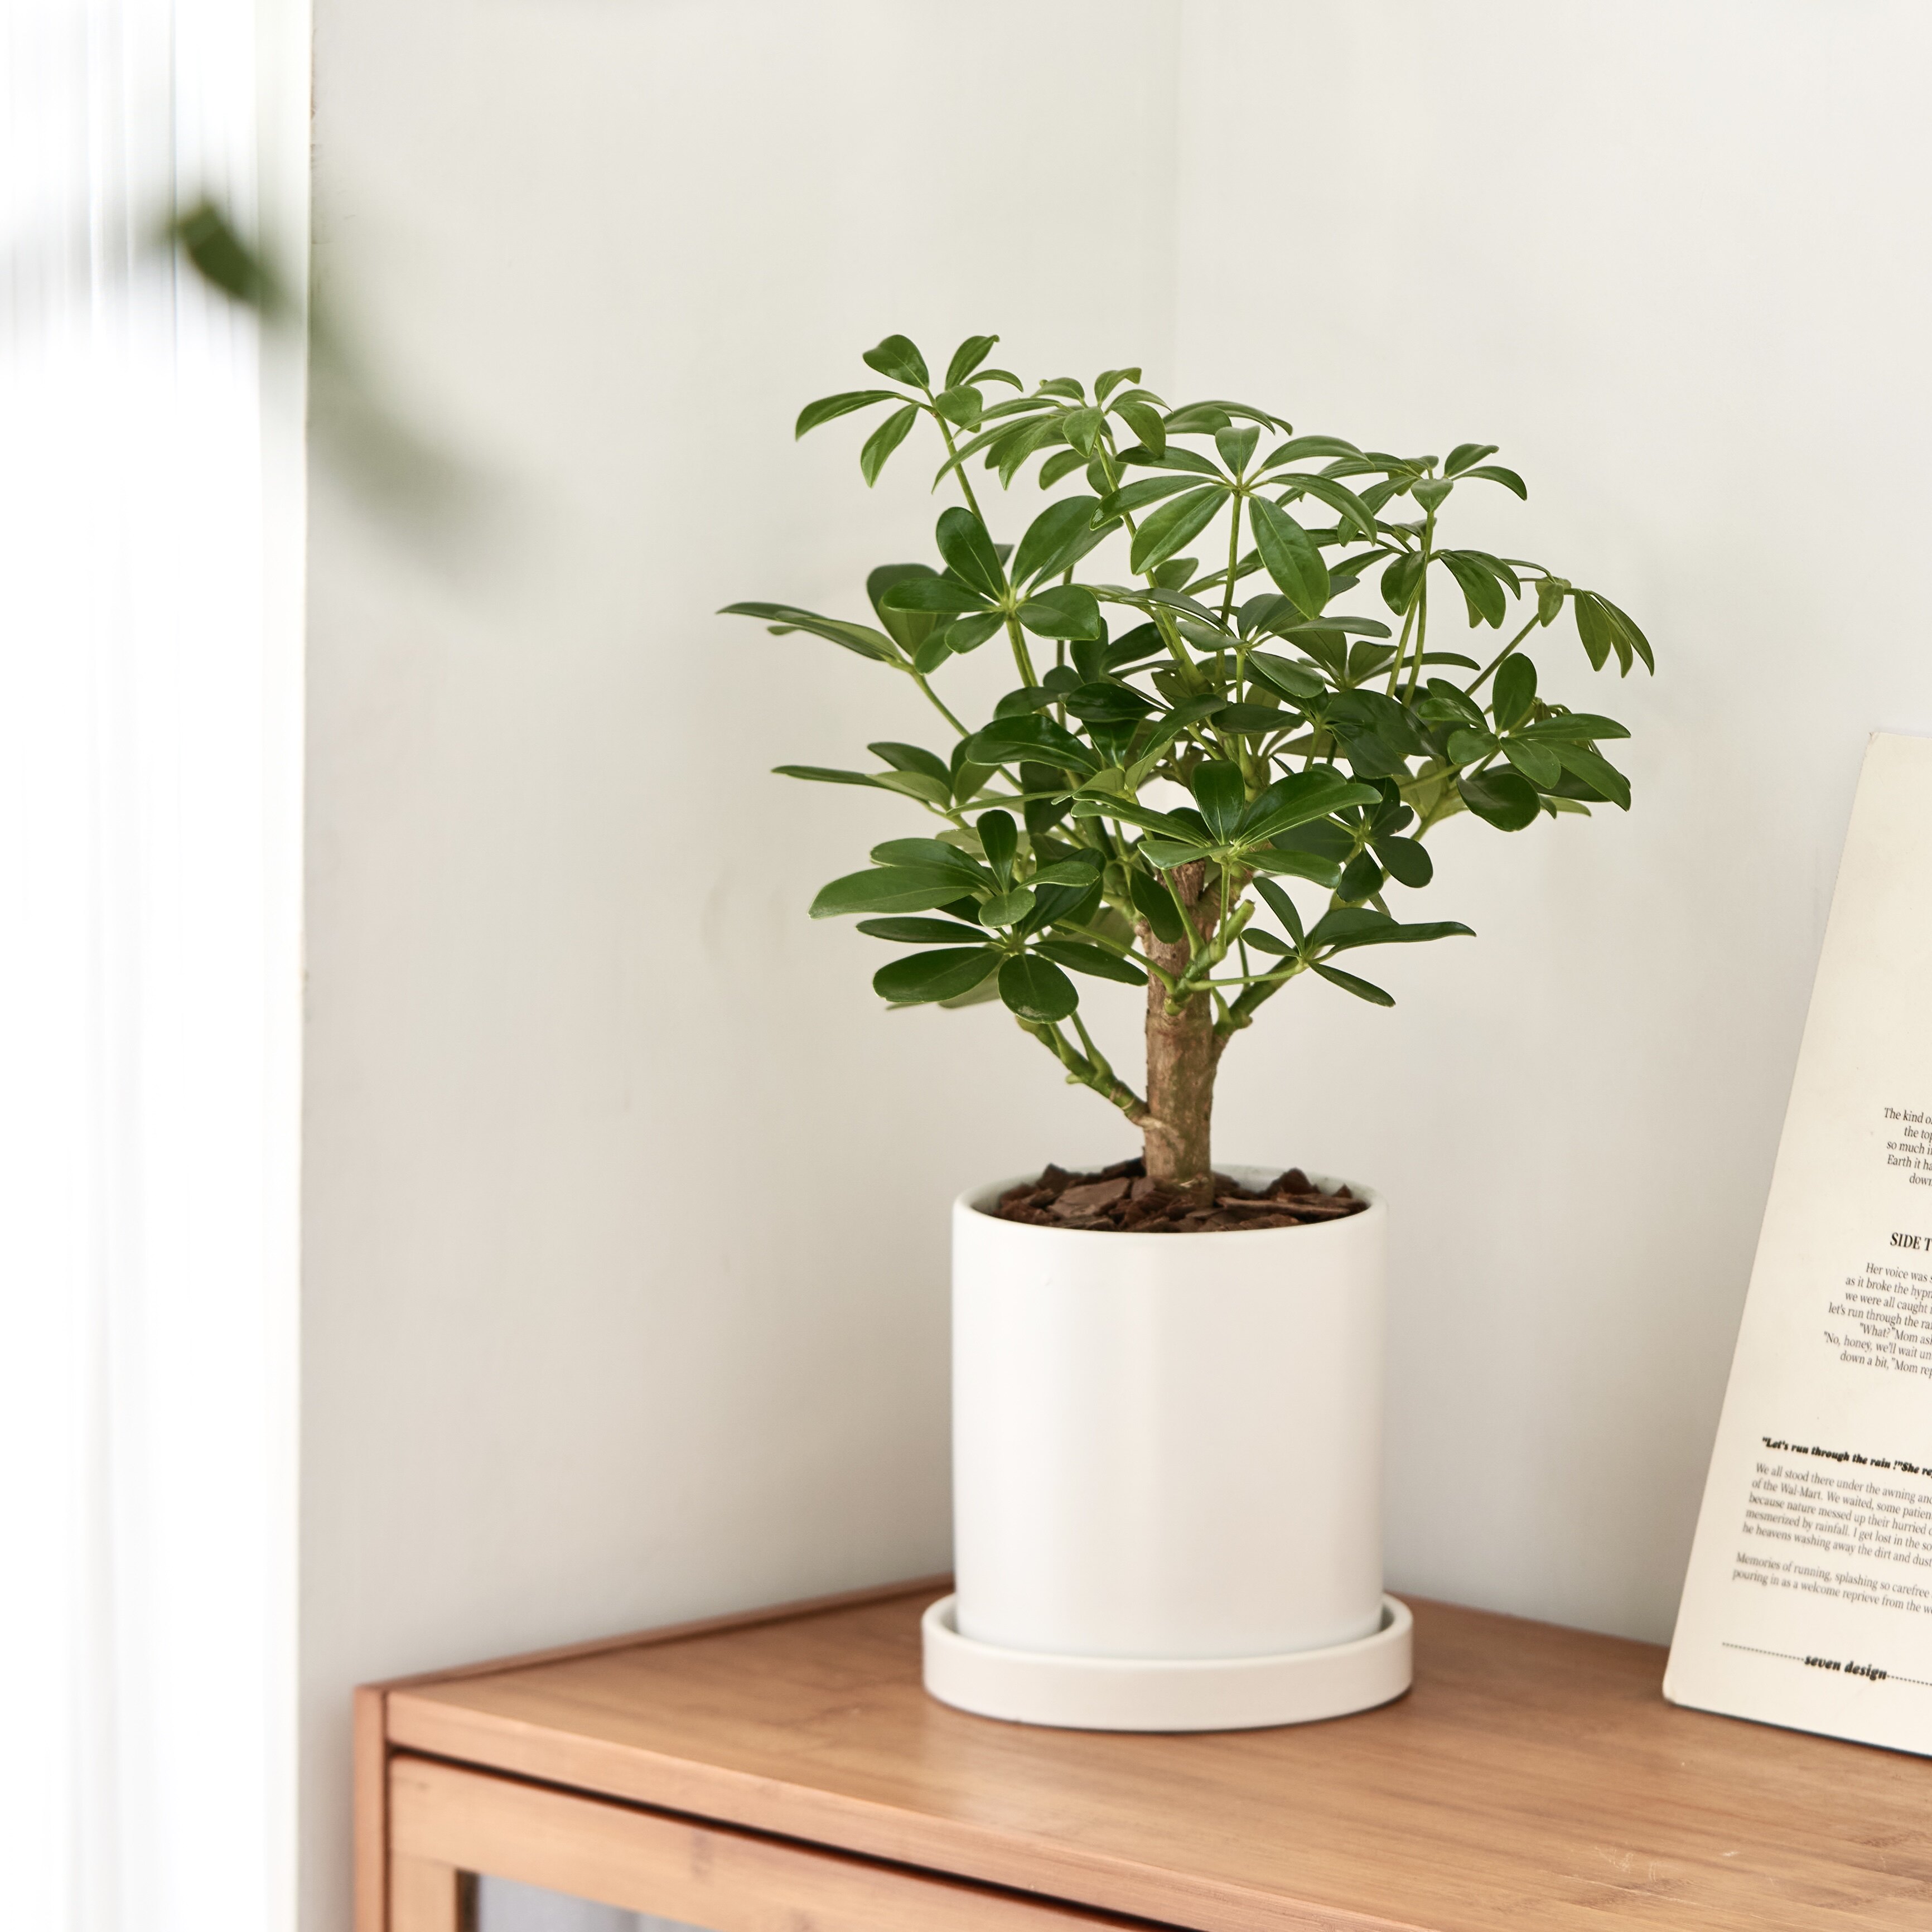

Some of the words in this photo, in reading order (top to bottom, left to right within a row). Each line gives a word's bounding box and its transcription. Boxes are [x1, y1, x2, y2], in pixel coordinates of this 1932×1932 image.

[1884, 1107, 1901, 1120] The
[1902, 1109, 1924, 1123] kind
[1925, 1116, 1932, 1125] o
[1904, 1125, 1919, 1138] the
[1886, 1141, 1897, 1150] so
[1899, 1142, 1925, 1155] much
[1887, 1153, 1912, 1168] Earth
[1914, 1157, 1921, 1170] it
[1890, 1232, 1921, 1250] SIDE
[1845, 1277, 1856, 1286] as
[1857, 1276, 1864, 1288] it
[1866, 1277, 1892, 1292] broke
[1894, 1282, 1909, 1295] the
[1866, 1262, 1883, 1275] Her
[1885, 1267, 1909, 1279] voice
[1911, 1272, 1928, 1283] was
[1828, 1301, 1846, 1316] let's
[1847, 1308, 1864, 1318] run
[1866, 1308, 1902, 1326] through
[1904, 1315, 1919, 1328] the
[1845, 1292, 1858, 1302] we
[1860, 1295, 1882, 1306] were
[1883, 1296, 1896, 1308] all
[1896, 1301, 1928, 1315] caught
[1824, 1331, 1841, 1347] "No,
[1843, 1334, 1872, 1353] honey,
[1876, 1341, 1897, 1354] we'll
[1898, 1346, 1917, 1358] wait
[1839, 1350, 1865, 1365] down
[1867, 1358, 1873, 1366] a
[1790, 1444, 1809, 1455] run
[1810, 1446, 1850, 1463] through
[1852, 1453, 1868, 1465] the
[1870, 1457, 1891, 1469] rain
[1756, 1462, 1770, 1475] We
[1770, 1465, 1784, 1478] all
[1784, 1470, 1810, 1482] stood
[1810, 1472, 1835, 1487] there
[1836, 1479, 1865, 1492] under
[1865, 1482, 1881, 1495] the
[1882, 1488, 1916, 1505] awning
[1751, 1477, 1763, 1489] of
[1763, 1479, 1778, 1492] the
[1781, 1482, 1823, 1500] Wal-Mart.
[1827, 1490, 1841, 1504] We
[1842, 1495, 1874, 1511] waited,
[1876, 1503, 1901, 1515] some
[1902, 1506, 1932, 1520] patien
[1749, 1491, 1785, 1509] because
[1786, 1501, 1817, 1515] nature
[1818, 1508, 1852, 1522] messed
[1853, 1514, 1866, 1527] up
[1867, 1514, 1890, 1528] their
[1891, 1518, 1927, 1535] hurried
[1745, 1509, 1801, 1528] mesmerized
[1801, 1516, 1813, 1533] by
[1815, 1521, 1850, 1537] rainfall.
[1853, 1527, 1858, 1538] I
[1858, 1530, 1873, 1542] get
[1875, 1530, 1892, 1544] lost
[1893, 1533, 1903, 1547] in
[1905, 1536, 1920, 1549] the
[1921, 1542, 1932, 1552] so
[1742, 1521, 1754, 1535] he
[1755, 1523, 1792, 1542] heavens
[1794, 1534, 1831, 1552] washing
[1832, 1542, 1856, 1556] away
[1857, 1543, 1873, 1556] the
[1874, 1546, 1891, 1560] dirt
[1892, 1552, 1911, 1564] and
[1912, 1553, 1932, 1568] dust
[1736, 1551, 1781, 1571] Memories
[1782, 1561, 1794, 1572] of
[1793, 1565, 1832, 1583] running,
[1834, 1572, 1878, 1591] splashing
[1880, 1582, 1891, 1591] so
[1892, 1583, 1930, 1598] carefree
[1732, 1569, 1769, 1587] pouring
[1770, 1573, 1780, 1586] in
[1781, 1578, 1791, 1588] as
[1793, 1581, 1799, 1590] a
[1801, 1581, 1841, 1597] welcome
[1842, 1590, 1880, 1605] reprieve
[1881, 1594, 1904, 1610] from
[1906, 1599, 1921, 1612] the
[1804, 1655, 1842, 1672] seven
[1844, 1660, 1887, 1682] design
